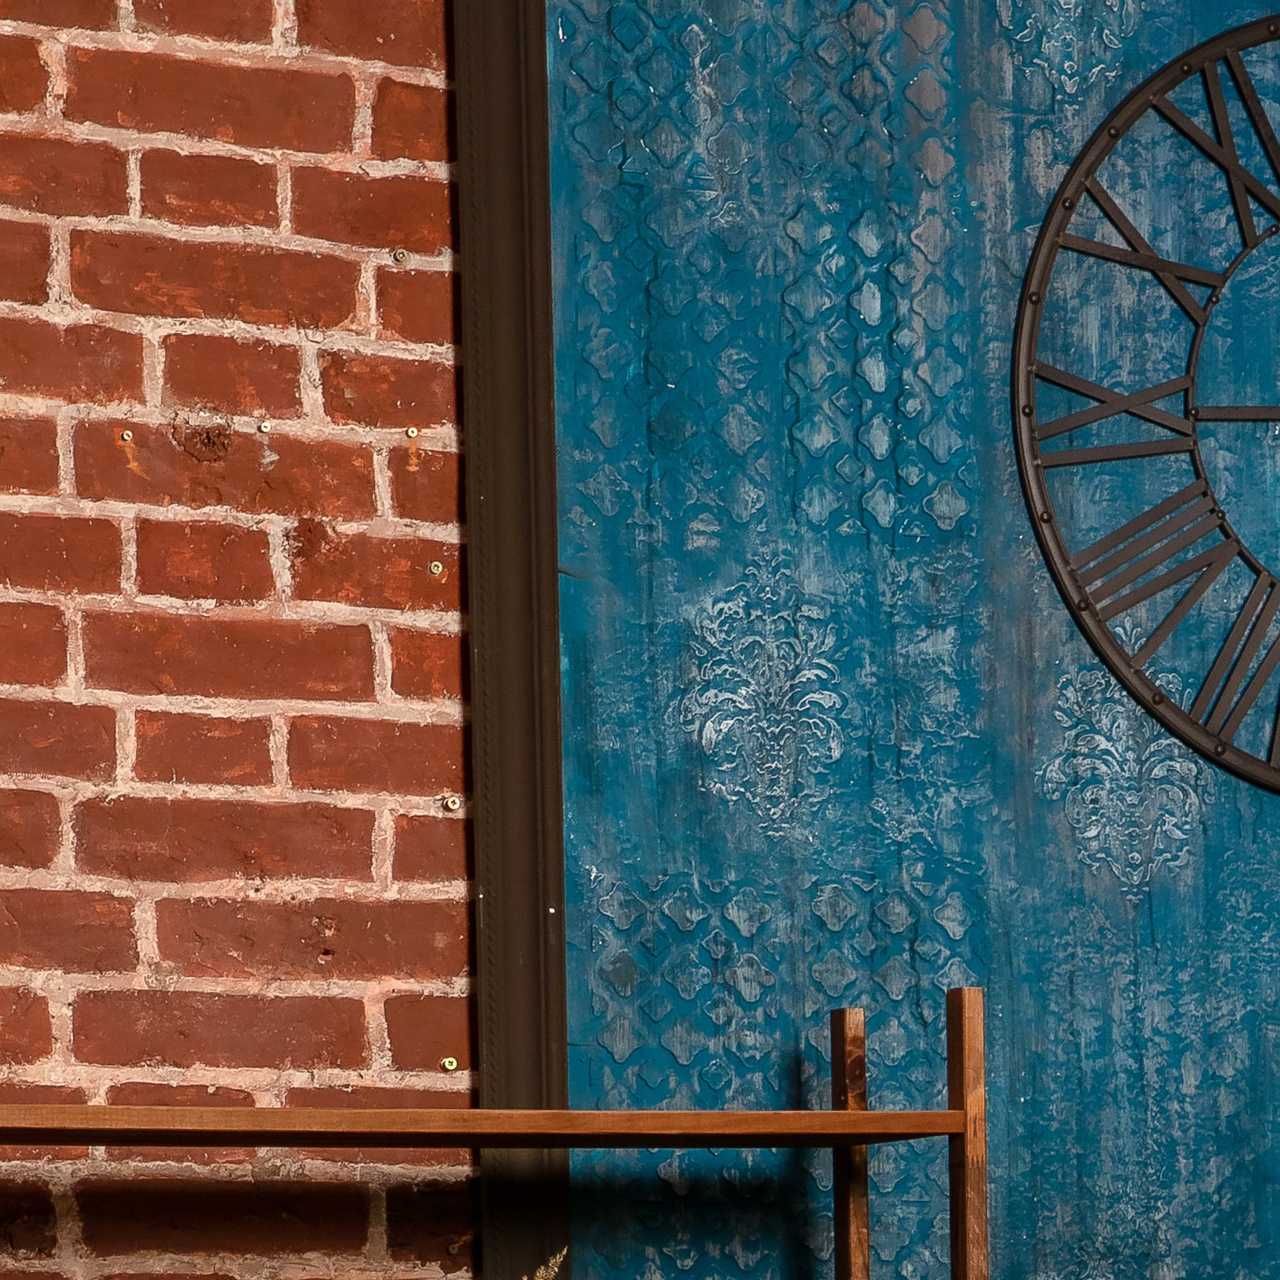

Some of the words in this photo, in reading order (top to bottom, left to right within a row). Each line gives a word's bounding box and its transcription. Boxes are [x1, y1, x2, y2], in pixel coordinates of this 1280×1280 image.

[1057, 178, 1227, 326] X
[1031, 363, 1195, 468] IX
[1069, 479, 1240, 670] VIII
